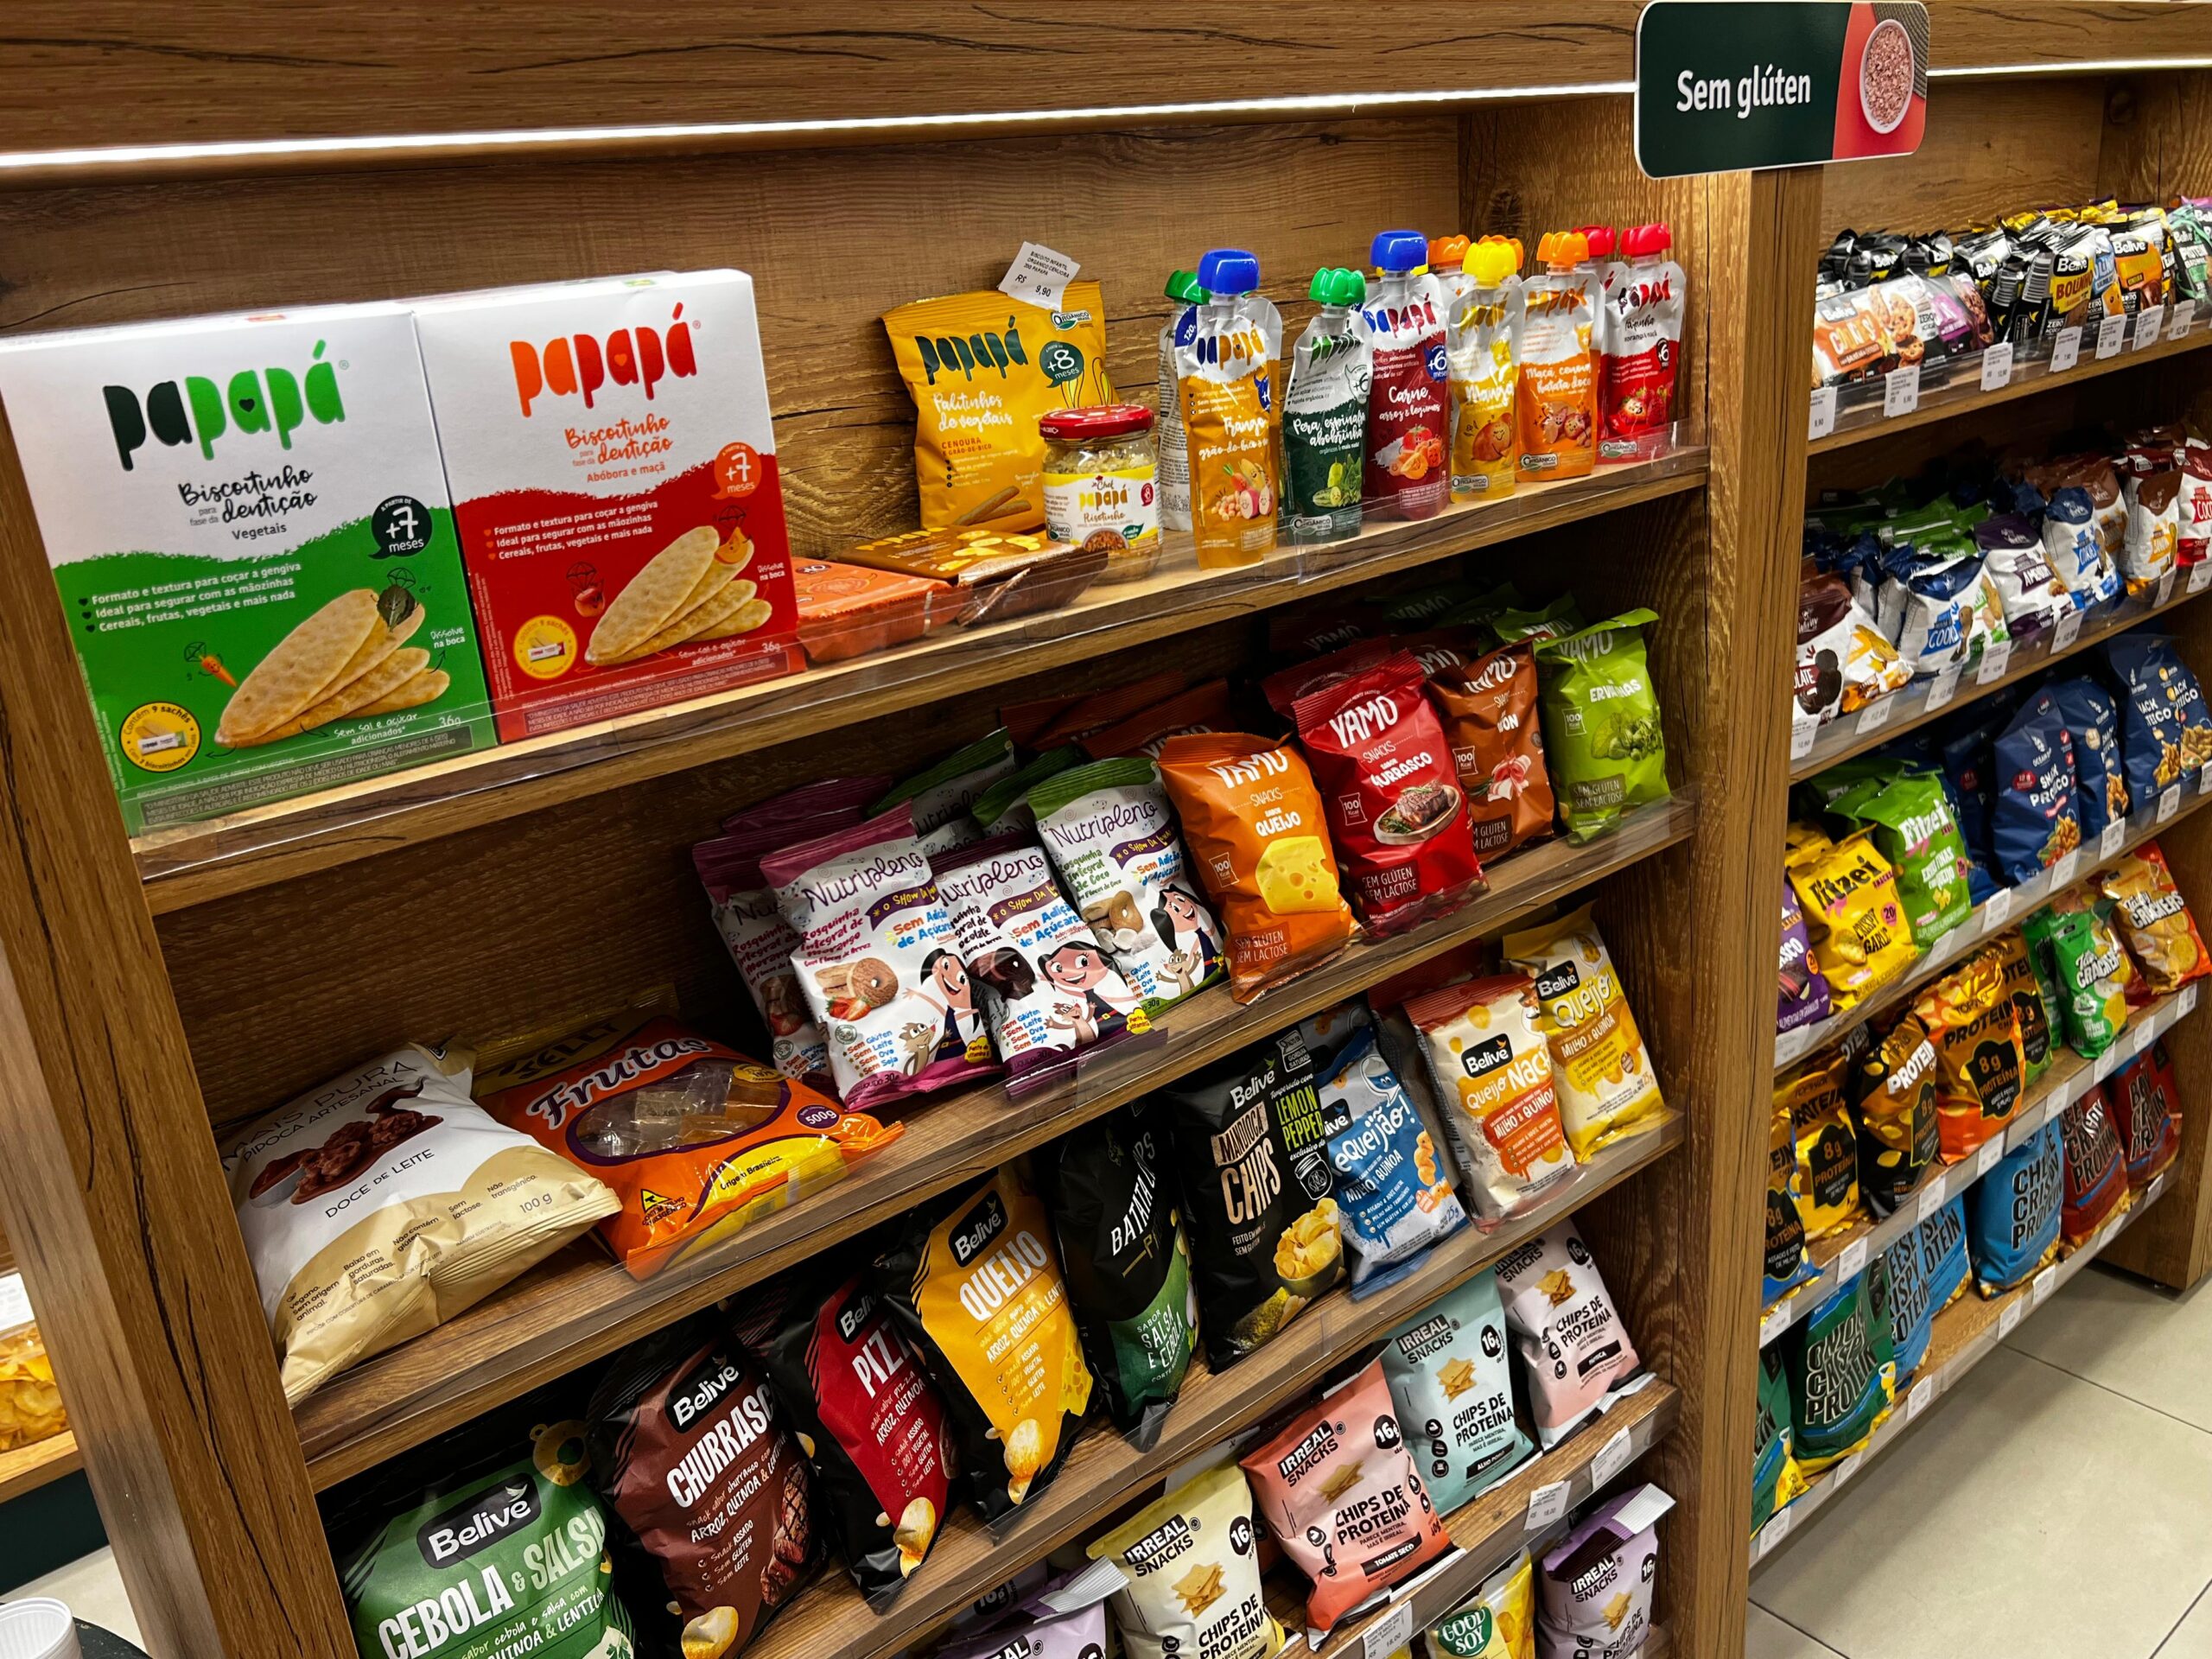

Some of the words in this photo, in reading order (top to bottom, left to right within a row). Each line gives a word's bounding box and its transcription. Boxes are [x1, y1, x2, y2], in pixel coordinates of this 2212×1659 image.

[1676, 69, 1731, 111] Sem
[1737, 63, 1811, 119] glúten
[2112, 240, 2147, 255] Belive
[1014, 274, 1027, 283] R$
[1035, 284, 1052, 297] 9,90
[2046, 318, 2065, 328] ZERO
[508, 301, 698, 418] papapá
[913, 315, 1029, 386] papapá
[1054, 365, 1080, 380] meses
[101, 338, 346, 472] papapá
[932, 390, 1003, 413] Palitinhos
[564, 412, 671, 449] Biscoitinho
[938, 411, 958, 432] de
[958, 409, 1014, 433] vegetais
[597, 435, 674, 465] dentição
[941, 436, 982, 449] CENOURA
[586, 467, 629, 483] Abóbora
[639, 461, 666, 475] maçã
[725, 451, 752, 482] +7
[177, 464, 314, 507] Biscoitinho
[726, 480, 756, 493] meses
[1078, 483, 1128, 512] papapá
[188, 518, 207, 527] fase
[198, 507, 218, 518] para
[221, 489, 318, 524] dentição
[385, 505, 419, 540] +7
[231, 522, 288, 541] Vegetais
[388, 537, 424, 554] meses
[92, 589, 140, 606] Formato
[142, 588, 149, 597] e
[150, 581, 193, 595] textura
[194, 576, 219, 590] para
[220, 571, 250, 585] coçar
[251, 570, 259, 579] a
[260, 562, 302, 579] gengiva
[95, 605, 124, 619] Ideal
[127, 602, 152, 615] para
[154, 594, 196, 609] segurar
[198, 590, 221, 601] com
[224, 587, 236, 597] as
[238, 575, 294, 594] mãozinhas
[99, 617, 145, 632] Cereais,
[146, 609, 184, 624] frutas,
[185, 602, 232, 617] vegetais
[233, 600, 241, 609] e
[243, 594, 268, 607] mais
[270, 589, 296, 601] nada
[429, 626, 465, 640] Dissolve
[433, 640, 444, 649] na
[445, 635, 466, 646] boca
[160, 705, 191, 724] sachês
[1329, 694, 1400, 749] YAMO
[1362, 739, 1396, 764] SNACKS
[1457, 752, 1474, 762] 100
[1207, 750, 1289, 789] YAMO
[1249, 786, 1283, 806] SNACKS
[1343, 798, 1360, 811] 100
[1050, 799, 1159, 848] Nutripleno
[1255, 810, 1302, 837] QUEIJO
[1897, 798, 1949, 852] Fitzei
[802, 849, 925, 913] Nutripleno
[1380, 866, 1414, 887] GLÚTEN
[1383, 878, 1418, 899] LACTOSE
[1808, 855, 1882, 911] Fitzei
[800, 906, 861, 944] Rosquinha
[1235, 937, 1251, 950] SEM
[1251, 928, 1284, 947] GLÚTEN
[1852, 907, 1880, 941] CRISPY
[1252, 942, 1289, 963] LACTOSE
[1536, 973, 1579, 998] Belive
[1554, 971, 1619, 1030] Queijo!
[1943, 997, 2013, 1050] PROTEIN
[846, 1040, 865, 1055] Sem
[865, 1028, 894, 1045] Glúten
[853, 1049, 872, 1064] Sem
[872, 1038, 894, 1052] Leite
[1465, 1047, 1510, 1076] Belive
[1978, 1053, 2001, 1074] 8g
[307, 1075, 406, 1123] ARTESANAL
[313, 1059, 420, 1108] PURA
[526, 1036, 713, 1132] Frutas
[1229, 1066, 1275, 1110] Belive
[1465, 1074, 1507, 1112] Queijo
[1978, 1067, 2019, 1099] PROTEÍNA
[804, 1106, 838, 1127] 500g
[1274, 1084, 1319, 1127] LEMON
[1217, 1104, 1264, 1164] MANDIOCA
[1281, 1109, 1325, 1154] PEPPER
[1492, 1118, 1518, 1141] MILHO
[1823, 1138, 1843, 1160] 8g
[324, 1183, 371, 1219] DOCE
[372, 1172, 391, 1186] DE
[391, 1147, 435, 1176] LEITE
[1219, 1137, 1282, 1226] CHIPS
[1813, 1154, 1857, 1186] PROTEÍNA
[486, 1180, 505, 1194] Não
[518, 1196, 541, 1215] 100
[542, 1192, 554, 1207] g
[448, 1198, 468, 1213] Sem
[452, 1201, 483, 1220] lactose.
[953, 1210, 1002, 1262] Belive
[957, 1229, 1049, 1323] QUEIJO
[1160, 1312, 1185, 1370] CEBOLA
[672, 1363, 741, 1428] Belive
[1804, 1348, 1878, 1425] PROTEIN
[1279, 1421, 1334, 1478] IRREAL
[1287, 1437, 1340, 1488] SNACKS
[690, 1513, 730, 1544] ARROZ,
[725, 1475, 762, 1518] QUINOA
[1335, 1497, 1382, 1527] CHIPS
[1382, 1483, 1405, 1506] DE
[1336, 1497, 1413, 1546] PROTEÍNA
[428, 1497, 532, 1562] Belive
[1373, 1548, 1398, 1568] TOMATE
[1395, 1541, 1416, 1558] SECO
[377, 1563, 516, 1659] CEBOLA
[511, 1570, 526, 1593] &
[523, 1505, 606, 1591] SALSA
[1440, 1606, 1487, 1644] GOOD
[1454, 1630, 1486, 1656] SOY
